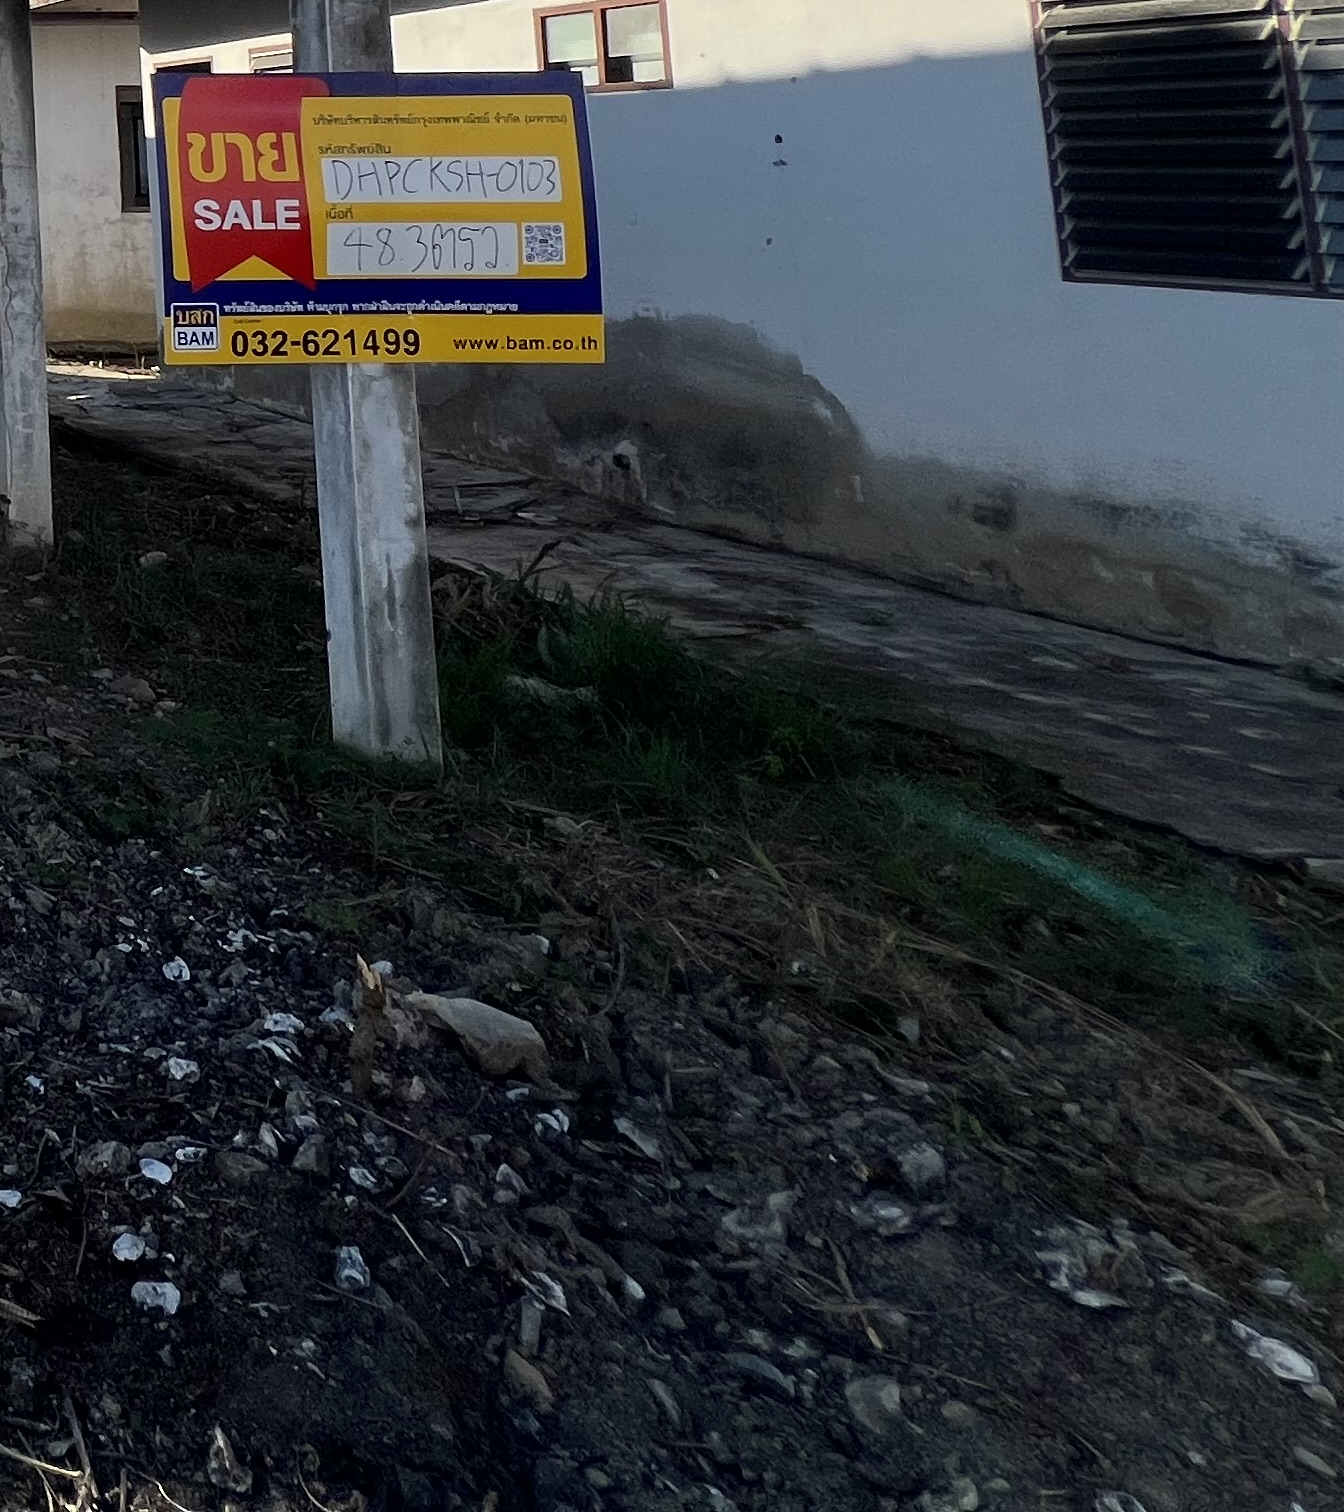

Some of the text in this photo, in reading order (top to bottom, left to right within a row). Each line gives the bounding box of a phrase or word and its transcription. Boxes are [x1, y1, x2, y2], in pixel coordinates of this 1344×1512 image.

[188, 131, 300, 183] ขาย
[193, 198, 302, 231] SALE
[325, 204, 354, 221] เนื้อที่
[176, 308, 215, 326] บสก
[177, 332, 215, 347] BAM
[231, 328, 421, 357] 032-621499
[452, 335, 598, 352] www.bam.co.th
